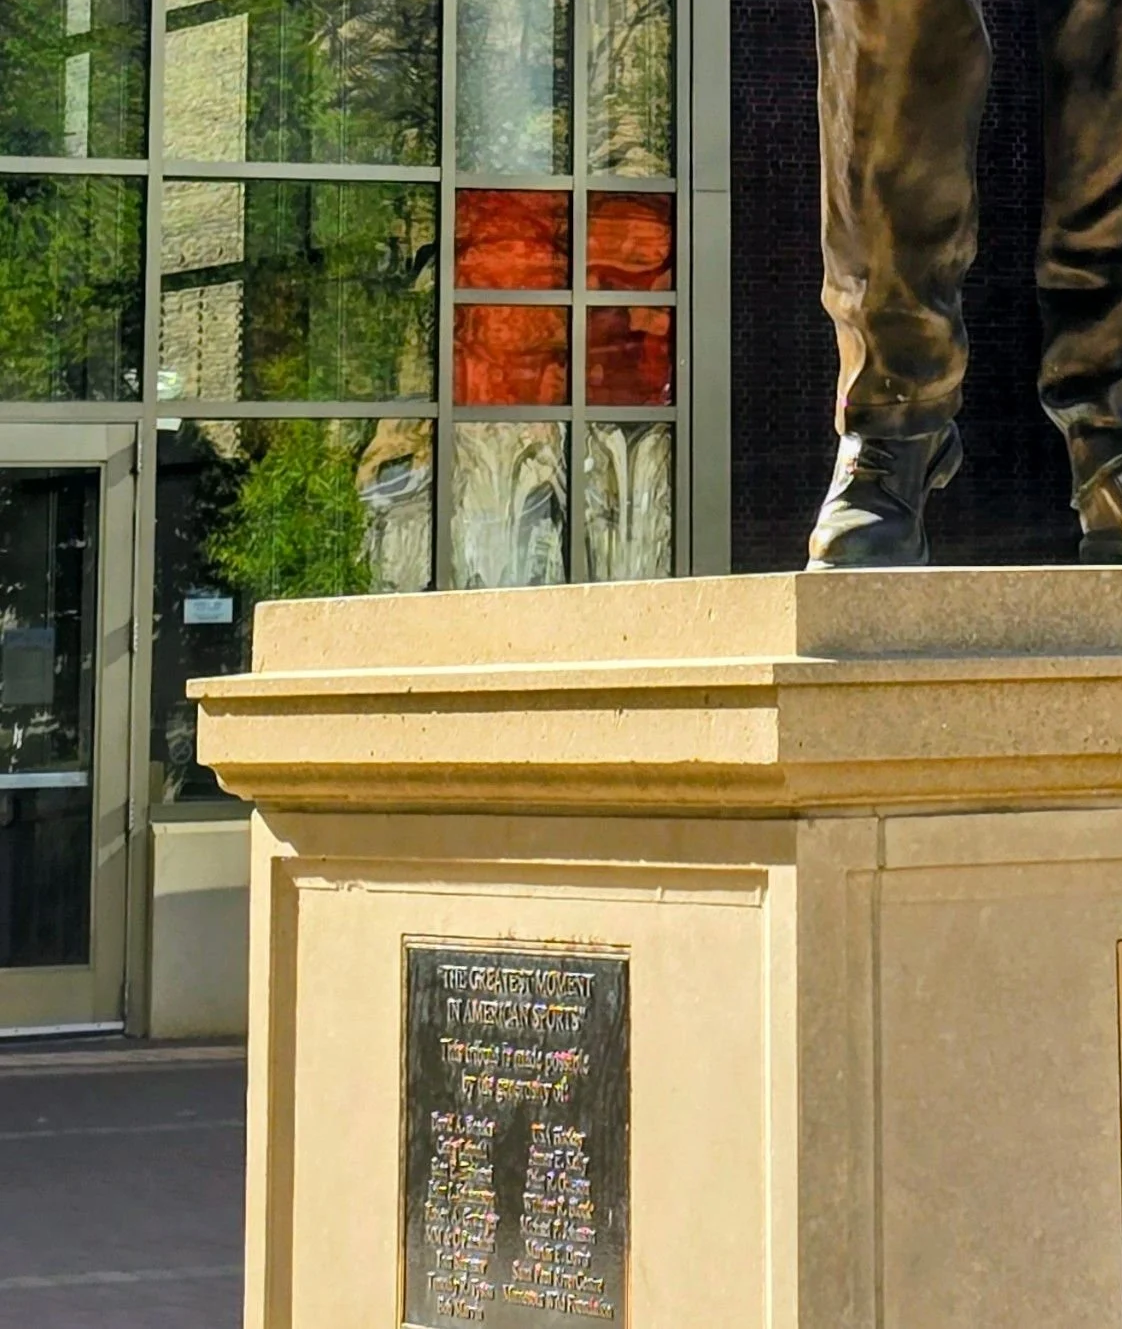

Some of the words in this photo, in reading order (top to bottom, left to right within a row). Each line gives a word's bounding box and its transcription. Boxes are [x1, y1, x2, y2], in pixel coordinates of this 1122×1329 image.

[469, 967, 533, 995] GREATEST
[535, 970, 595, 997] MOMENT
[447, 998, 462, 1022] IN
[463, 999, 531, 1029] AMERICAN
